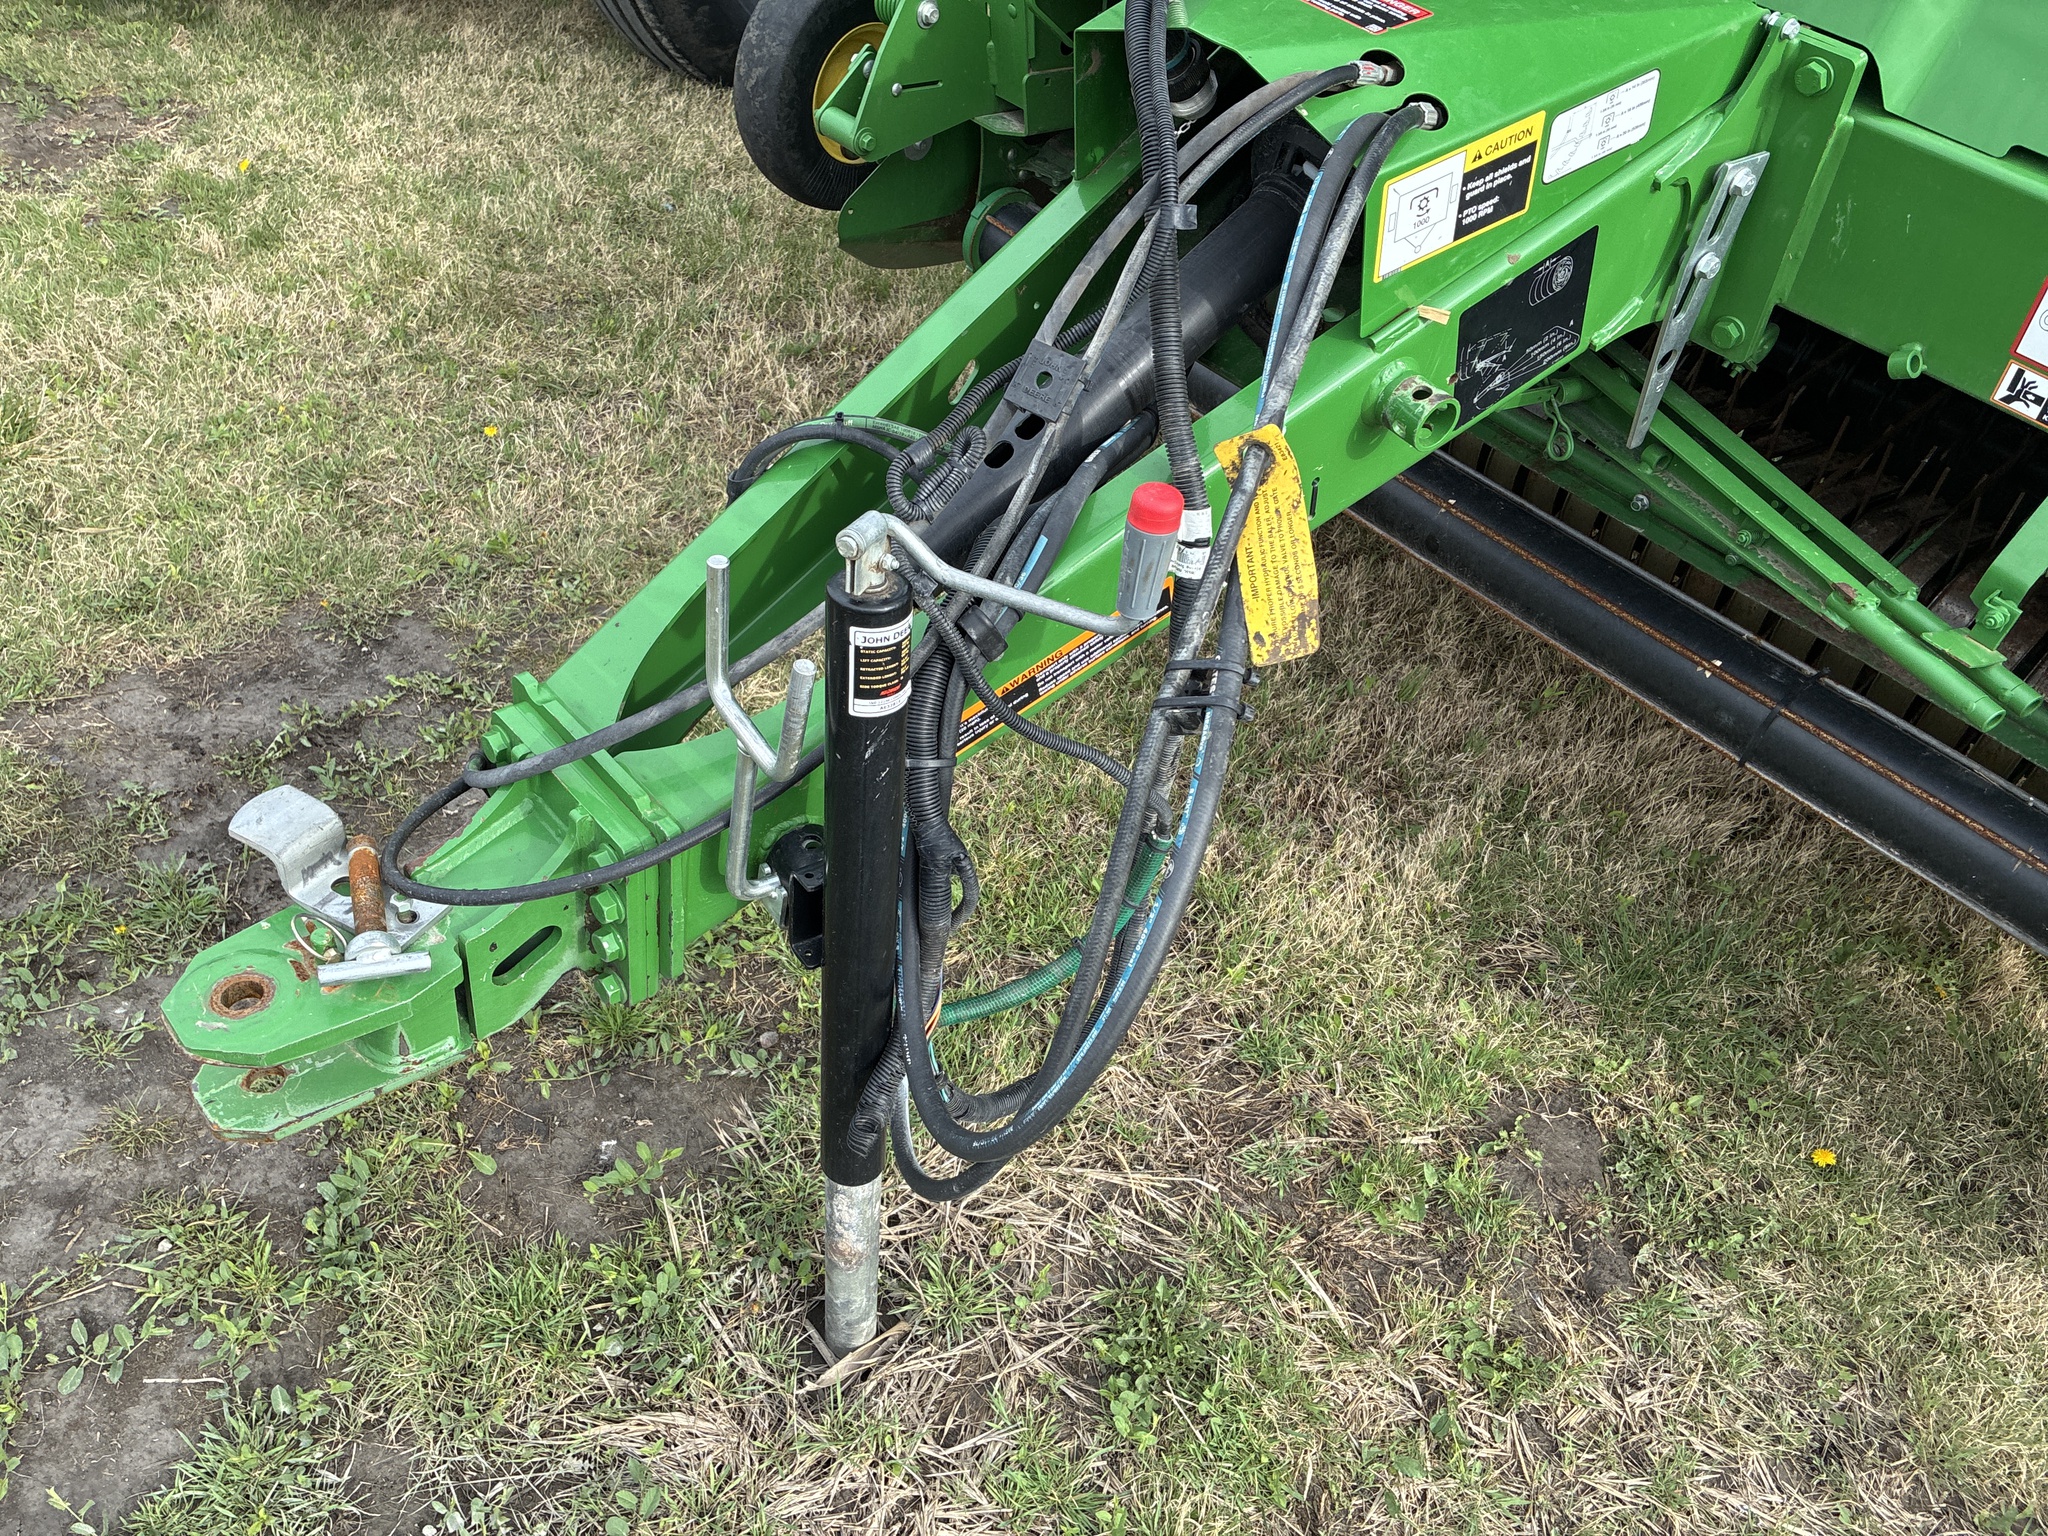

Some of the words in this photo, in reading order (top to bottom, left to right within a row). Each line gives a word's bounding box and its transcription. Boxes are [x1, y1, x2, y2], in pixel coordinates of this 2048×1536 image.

[1484, 125, 1533, 156] CAUTION
[1467, 178, 1484, 190] Keep
[1485, 172, 1493, 182] all
[1494, 162, 1517, 178] shields
[1518, 155, 1531, 167] and
[1466, 184, 1485, 200] guard
[1486, 182, 1492, 190] in
[1462, 213, 1477, 225] 1000
[1478, 205, 1493, 218] RPM
[1463, 205, 1477, 217] PTO
[1413, 216, 1430, 230] 1000
[1039, 357, 1061, 372] JOHN
[1022, 385, 1051, 402] DEERE
[1262, 489, 1270, 513] ADJUST
[1255, 515, 1264, 547] FUNCTION
[1278, 533, 1284, 542] TO
[1270, 554, 1277, 563] TO
[1292, 550, 1302, 583] SECONDS
[1272, 564, 1282, 595] DAMAGE
[1265, 587, 1275, 615] PROPER
[861, 635, 890, 644] JOHN
[893, 624, 911, 640] DEE
[1009, 650, 1064, 689] WARNING
[1013, 693, 1029, 704] during
[975, 724, 988, 734] injury
[1149, 902, 1159, 924] 1/2"
[1135, 927, 1148, 951] 4000
[1128, 953, 1137, 967] psi
